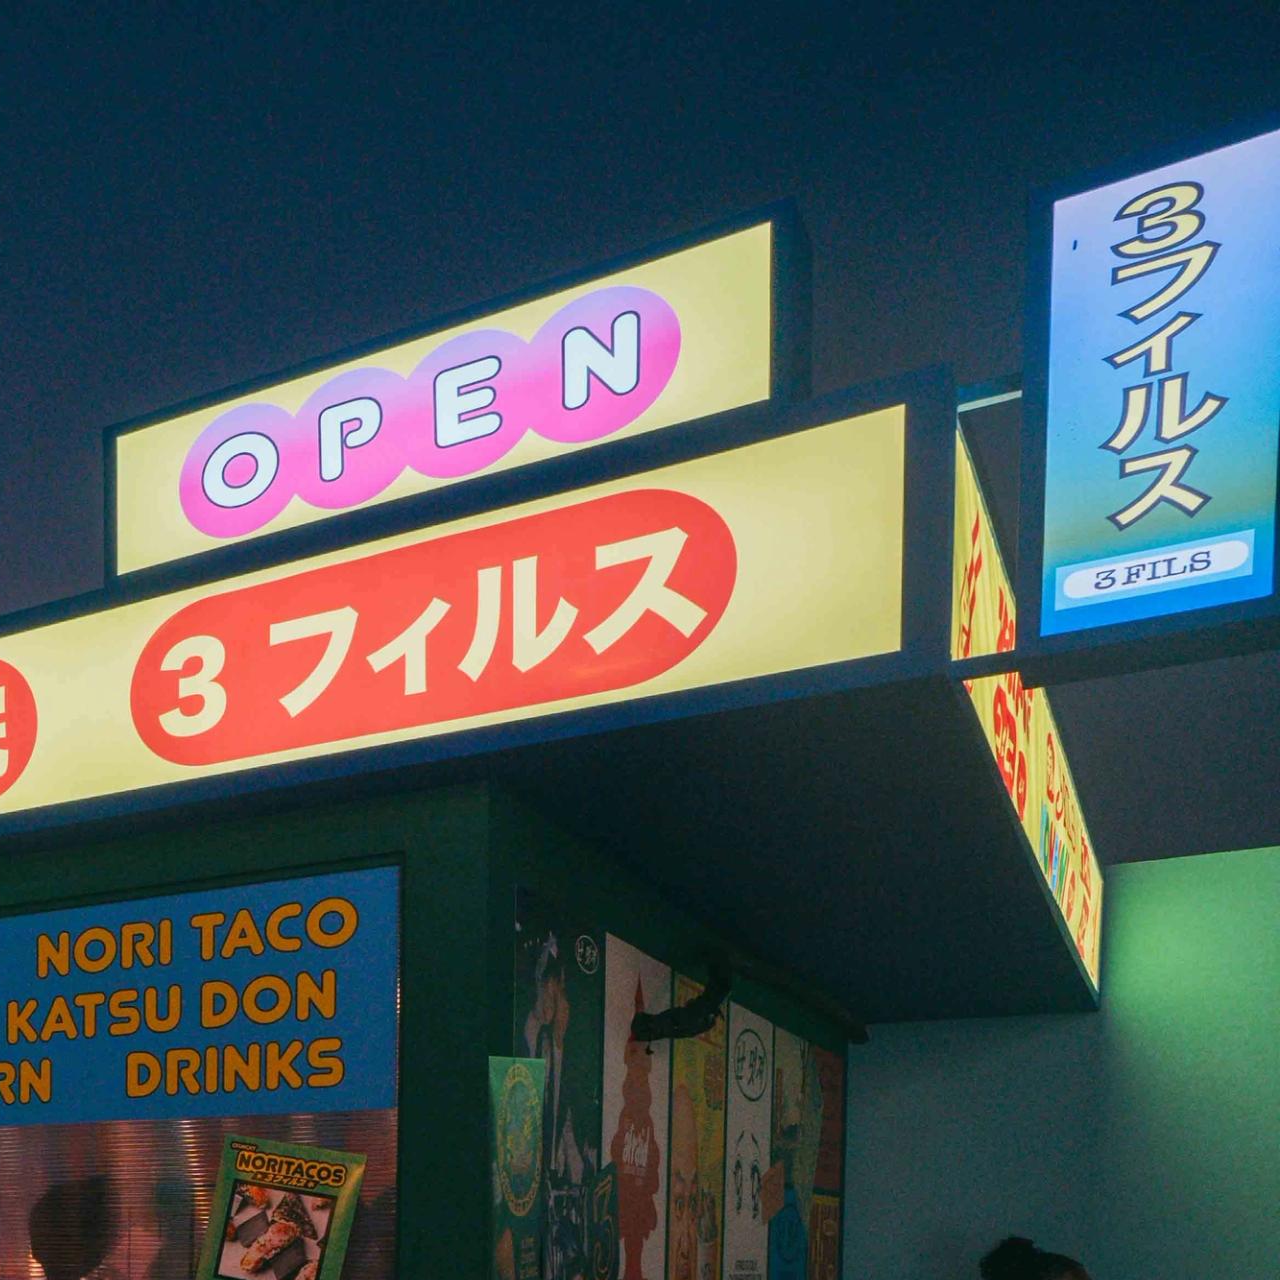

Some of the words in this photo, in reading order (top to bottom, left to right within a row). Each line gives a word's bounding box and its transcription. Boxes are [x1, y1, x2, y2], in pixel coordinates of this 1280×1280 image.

[1098, 180, 1230, 532] 3フィルス
[201, 310, 641, 509] OPEN
[37, 918, 173, 979] NORI
[190, 897, 359, 961] TACO
[6, 984, 182, 1045] KATSU
[200, 969, 337, 1030] DON
[125, 1037, 345, 1098] DRINKS
[237, 1152, 345, 1185] NORITACOS
